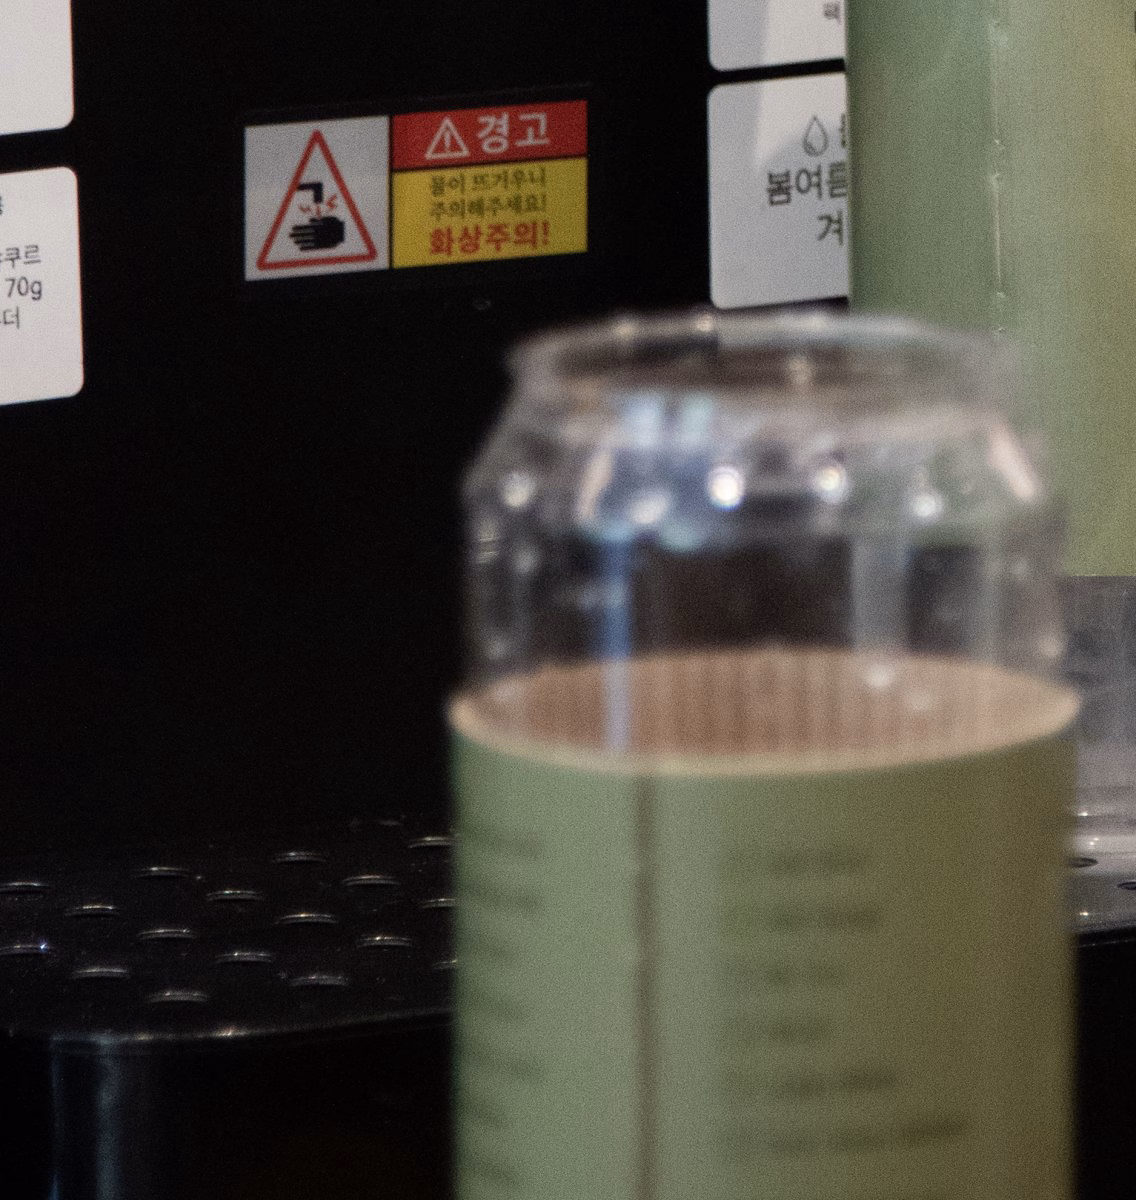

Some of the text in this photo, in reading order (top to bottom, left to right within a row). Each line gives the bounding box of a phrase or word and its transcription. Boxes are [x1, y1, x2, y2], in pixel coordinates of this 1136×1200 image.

[476, 111, 552, 154] 경고
[430, 220, 551, 257] 화상주의!
[4, 276, 43, 302] 70g
